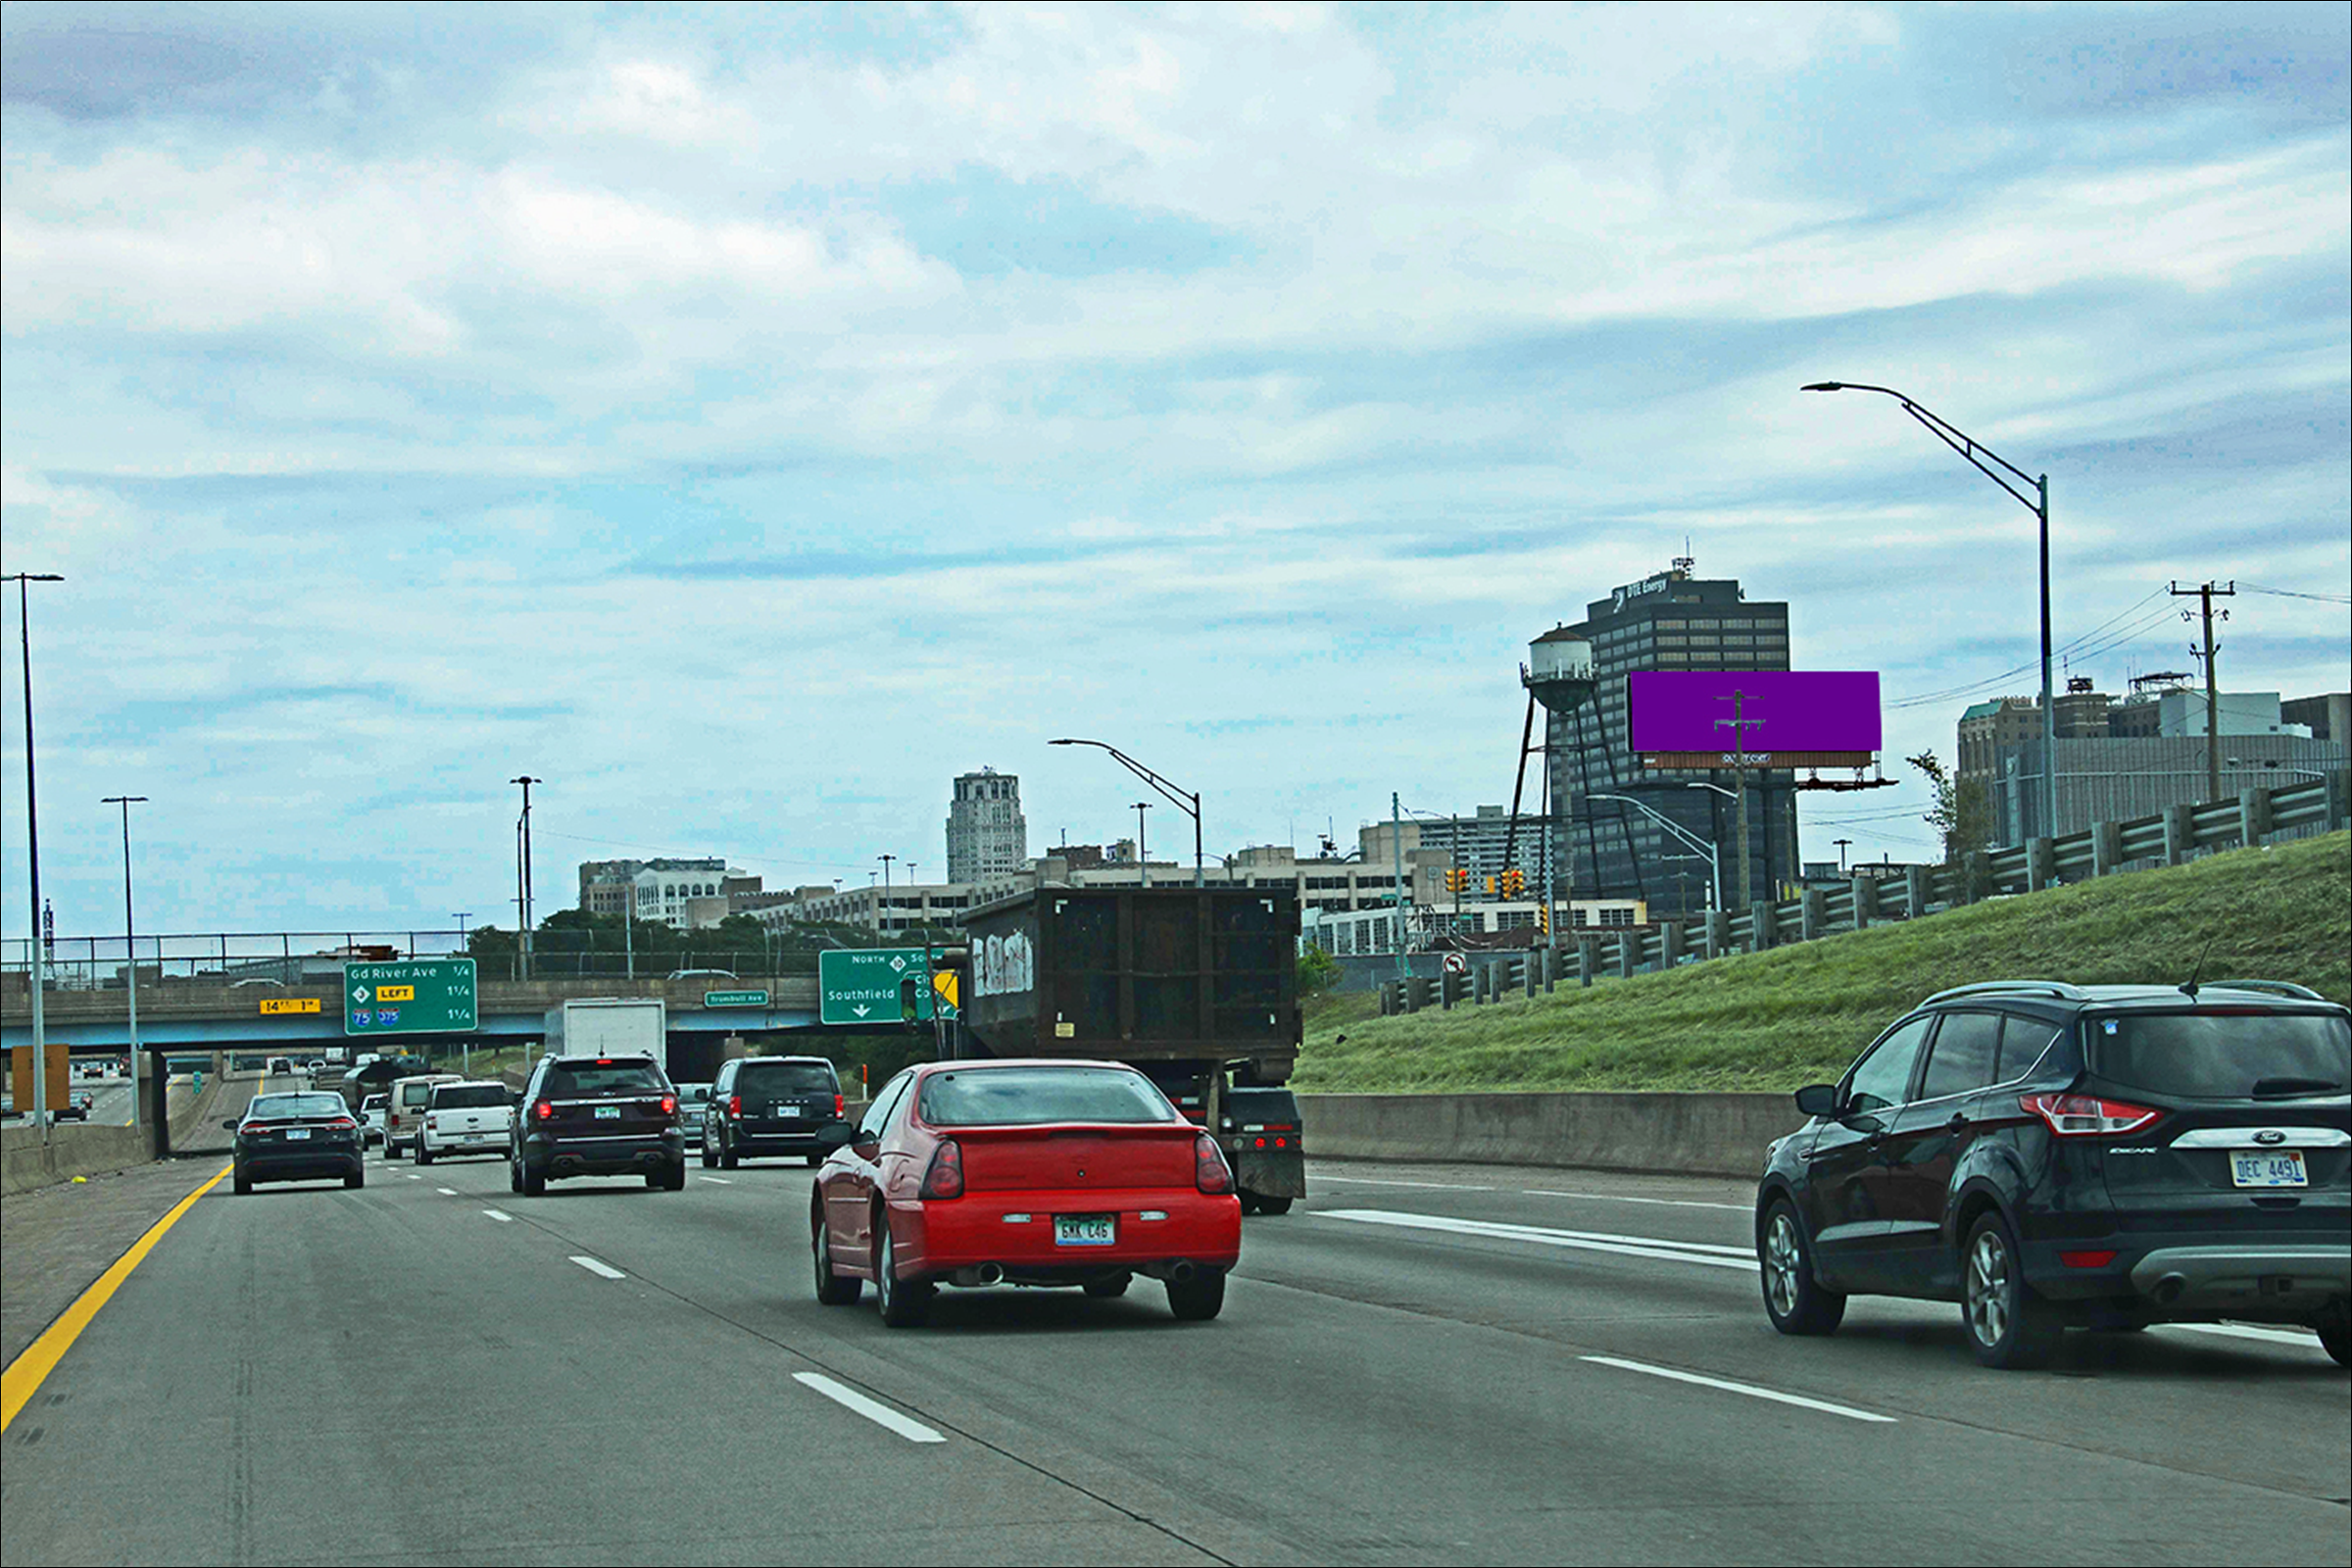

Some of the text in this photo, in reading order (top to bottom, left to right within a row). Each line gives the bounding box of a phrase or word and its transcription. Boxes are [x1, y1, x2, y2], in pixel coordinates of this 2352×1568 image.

[1642, 579, 1667, 594] Energy
[852, 956, 885, 964] NORTH
[351, 968, 368, 979] Gd
[372, 967, 408, 978] River
[413, 966, 436, 977] Ave
[381, 989, 409, 998] LEFT
[828, 989, 895, 1001] Southfield
[355, 1013, 370, 1023] 75
